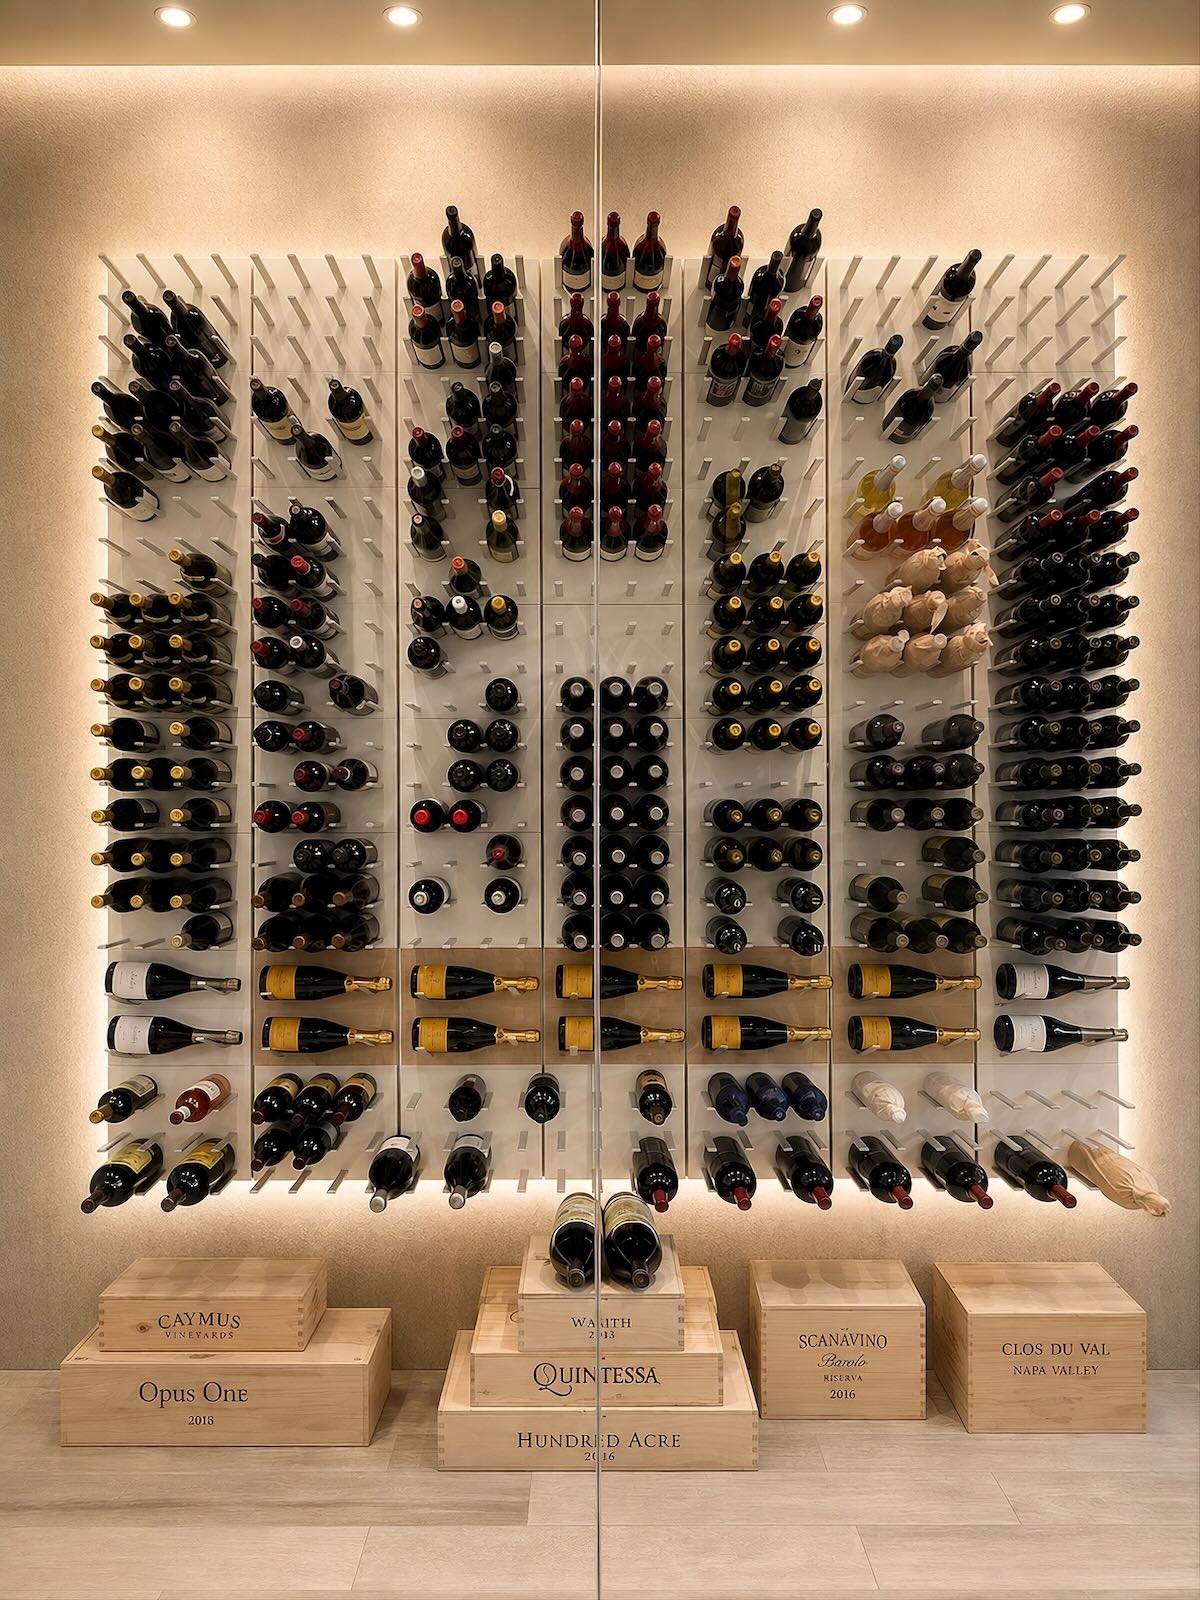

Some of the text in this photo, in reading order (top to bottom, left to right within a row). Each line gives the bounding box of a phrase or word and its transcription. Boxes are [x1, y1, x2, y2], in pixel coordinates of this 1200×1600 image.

[158, 1312, 241, 1329] CAYMUS
[1002, 1343, 1110, 1356] CLOS DU VAL
[817, 1353, 868, 1367] Barolo
[1013, 1365, 1099, 1375] NAPA VALLEY
[533, 1362, 660, 1397] QUINTESSA
[139, 1381, 249, 1408] Opus One
[830, 1389, 856, 1399] 2016
[188, 1416, 214, 1425] 2018
[628, 1432, 681, 1448] ACRE
